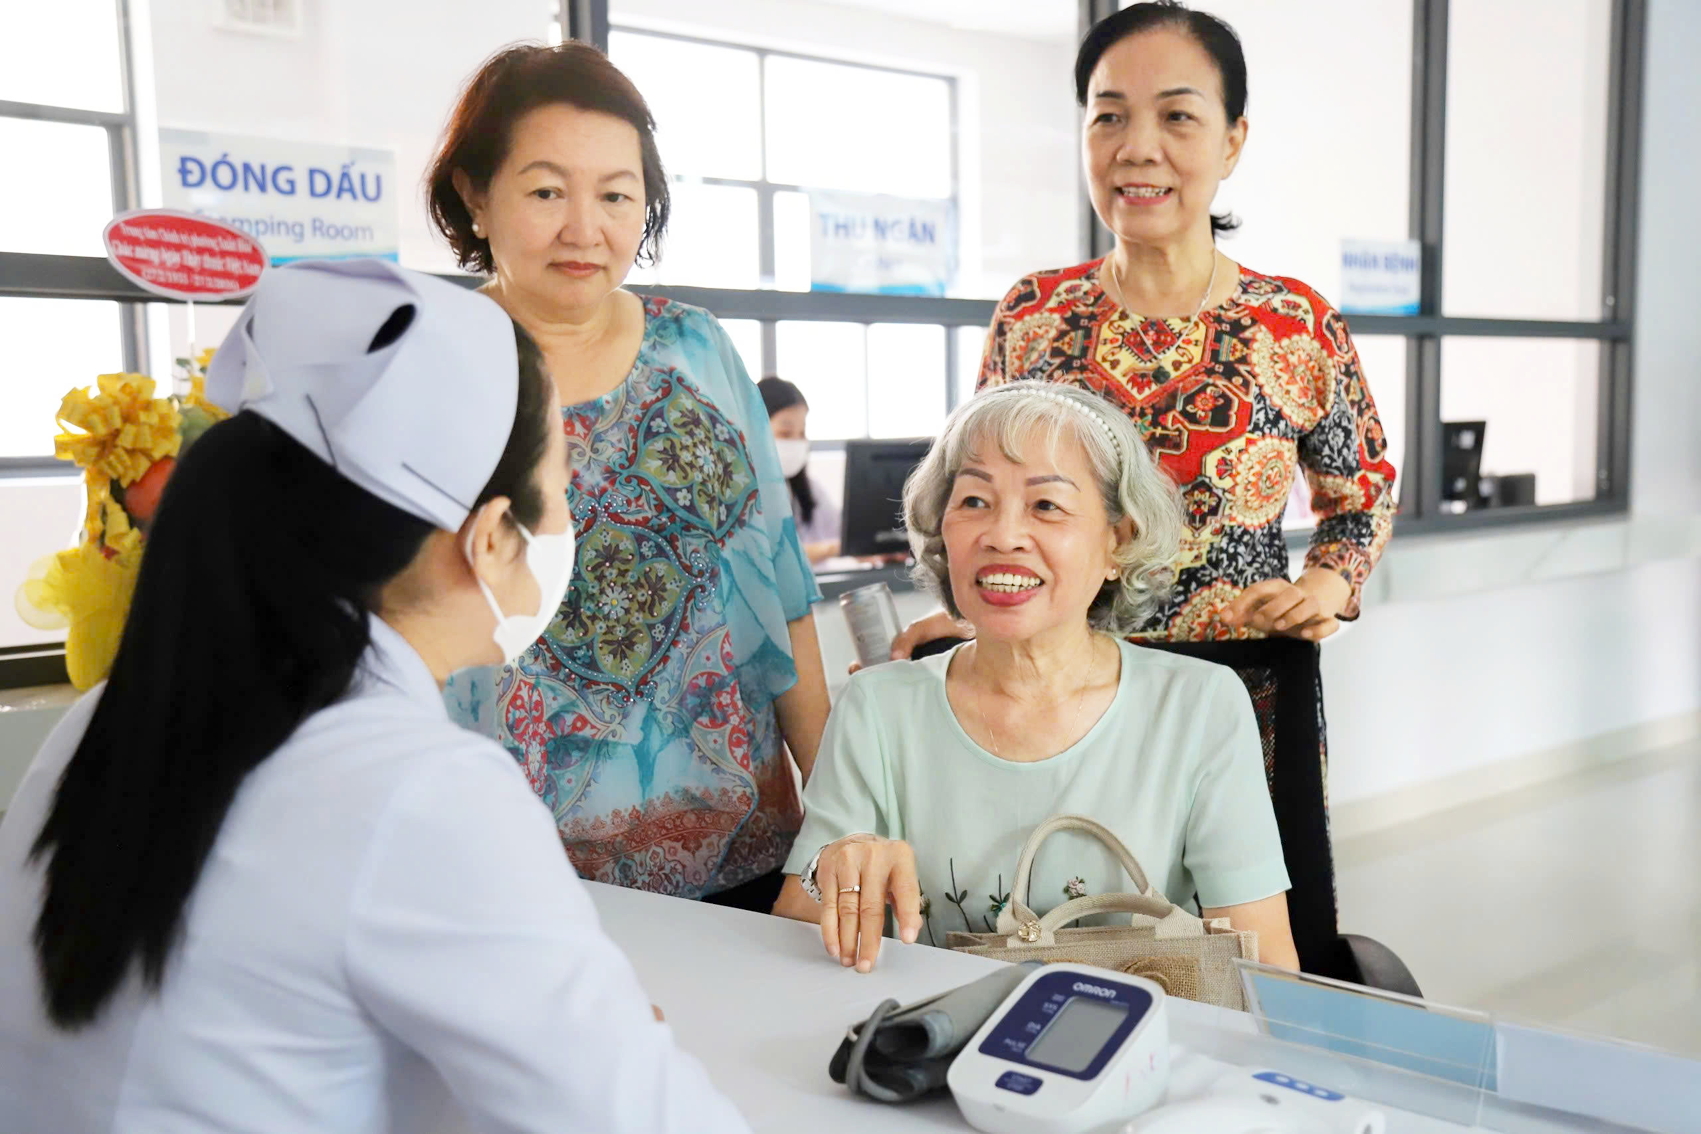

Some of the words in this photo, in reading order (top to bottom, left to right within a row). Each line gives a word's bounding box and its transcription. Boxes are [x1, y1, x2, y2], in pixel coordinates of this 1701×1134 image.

[177, 153, 296, 196] ĐÓNG
[308, 162, 382, 202] DẤU
[196, 208, 304, 243] mping
[311, 217, 374, 242] Room
